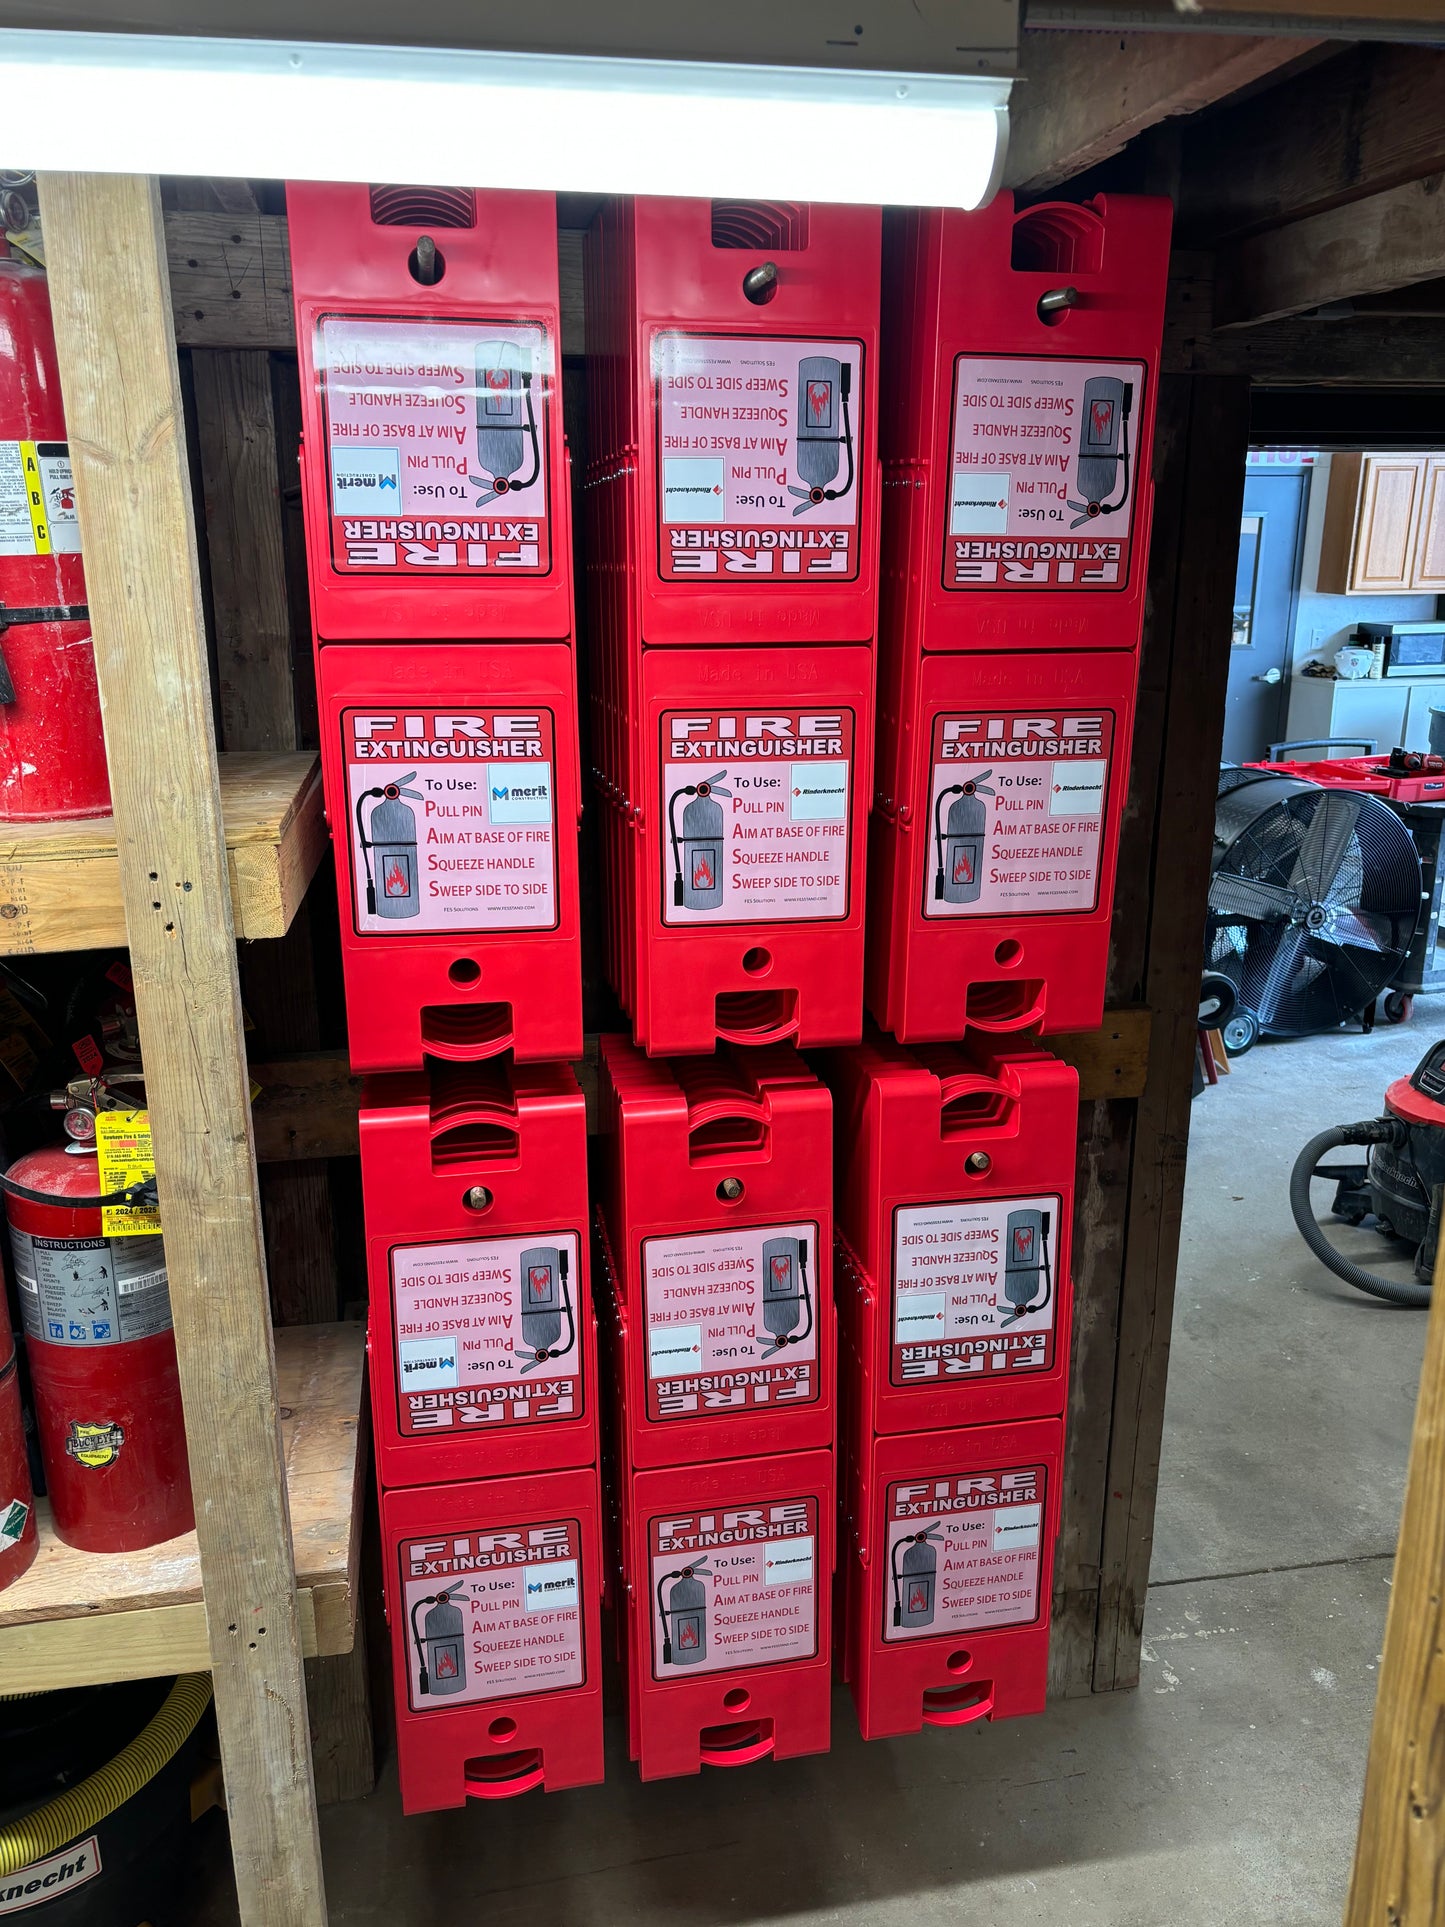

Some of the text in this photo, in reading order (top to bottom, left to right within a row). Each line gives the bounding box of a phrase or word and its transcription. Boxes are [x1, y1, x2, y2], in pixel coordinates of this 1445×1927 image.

[668, 376, 788, 397] SWEEP SIDE TO SIDE
[681, 407, 787, 426] SQUEEZE HANDLE
[665, 436, 787, 456] AIM AT BASE OF FIRE
[27, 457, 36, 471] A
[732, 467, 786, 485] PULL PIN
[32, 492, 40, 505] B
[736, 496, 785, 508] To Use:
[37, 525, 46, 539] C
[345, 521, 537, 541] EXTINGUISHER
[671, 530, 847, 548] EXTINGUISHER
[348, 542, 537, 566] FIRE
[956, 542, 1119, 560] EXTINGUISHER
[672, 550, 847, 573] FIRE
[956, 561, 1117, 583] FIRE
[354, 716, 539, 738] FIRE
[673, 716, 841, 739] FIRE
[945, 717, 1102, 740] FIRE
[355, 740, 541, 758] EXTINGUISHER
[672, 739, 841, 758] EXTINGUISHER
[943, 739, 1101, 758] EXTINGUISHER
[425, 779, 476, 790] To Use:
[734, 777, 780, 788] To Use:
[998, 776, 1042, 786] To Use:
[512, 786, 547, 796] merit
[426, 801, 482, 817] PULL PIN
[733, 798, 784, 813] PULL PIN
[996, 796, 1043, 810] PULL PIN
[427, 828, 549, 844] AIM AT BASE OF FIRE
[733, 824, 844, 838] AIM AT BASE OF FIRE
[993, 821, 1098, 835] AIM AT BASE OF FIRE
[733, 849, 829, 864] SQUEEZE HANDLE
[992, 845, 1082, 860] SQUEEZE HANDLE
[428, 854, 534, 871] SQUEEZE HANDLE
[733, 874, 839, 888] SWEEP SIDE TO SIDE
[990, 869, 1090, 883] SWEEP SIDE TO SIDE
[430, 881, 547, 896] SWEEP SIDE TO SIDE
[35, 1238, 106, 1248] INSTRUCTIONS
[902, 1335, 1045, 1360] EXTINGUISHER
[902, 1349, 1044, 1378] FIRE
[658, 1366, 809, 1395] EXTINGUISHER
[410, 1381, 572, 1409] EXTINGUISHER
[659, 1380, 809, 1413] FIRE
[412, 1396, 572, 1428] FIRE
[897, 1472, 1035, 1502] FIRE
[897, 1489, 1035, 1516] EXTINGUISHER
[660, 1504, 806, 1537] FIRE
[410, 1527, 568, 1561] FIRE
[660, 1521, 807, 1551] EXTINGUISHER
[411, 1545, 569, 1575] EXTINGUISHER
[470, 1582, 514, 1593] To Use:
[544, 1578, 575, 1589] merit
[471, 1600, 519, 1613] PULL PIN
[472, 1612, 577, 1633] AIM AT BASE OF FIRE
[474, 1633, 564, 1653] SQUEEZE HANDLE
[475, 1652, 575, 1673] SWEEP SIDE TO SIDE
